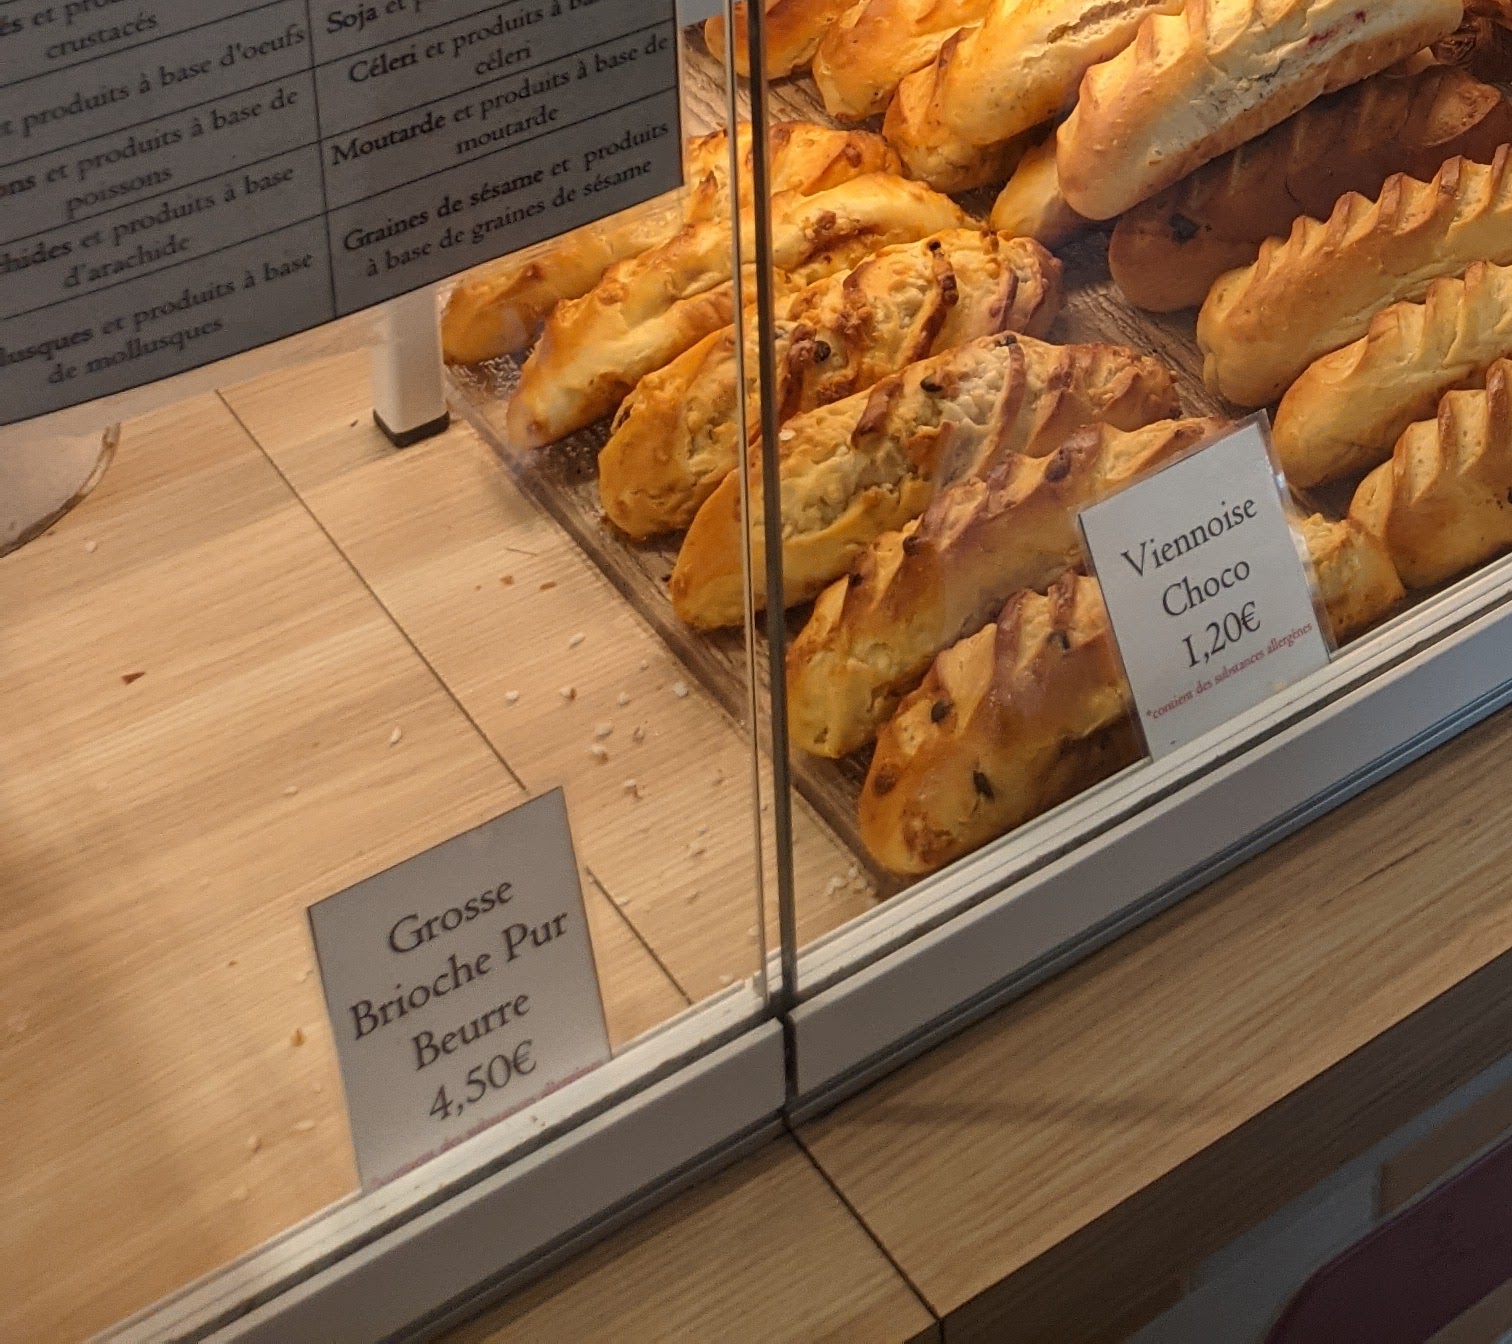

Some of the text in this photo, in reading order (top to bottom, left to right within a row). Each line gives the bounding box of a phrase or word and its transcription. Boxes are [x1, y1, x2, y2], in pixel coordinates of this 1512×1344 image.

[326, 2, 378, 35] Soja
[1120, 498, 1258, 577] Viennoise
[1162, 560, 1250, 617] Choco
[1182, 600, 1261, 668] 1,20€
[1196, 678, 1214, 694] des
[1214, 649, 1266, 686] substances
[388, 880, 515, 954] Grosse
[348, 910, 570, 1042] Brioche Pur
[411, 993, 531, 1072] Beurre
[428, 1038, 538, 1123] 4,50€
